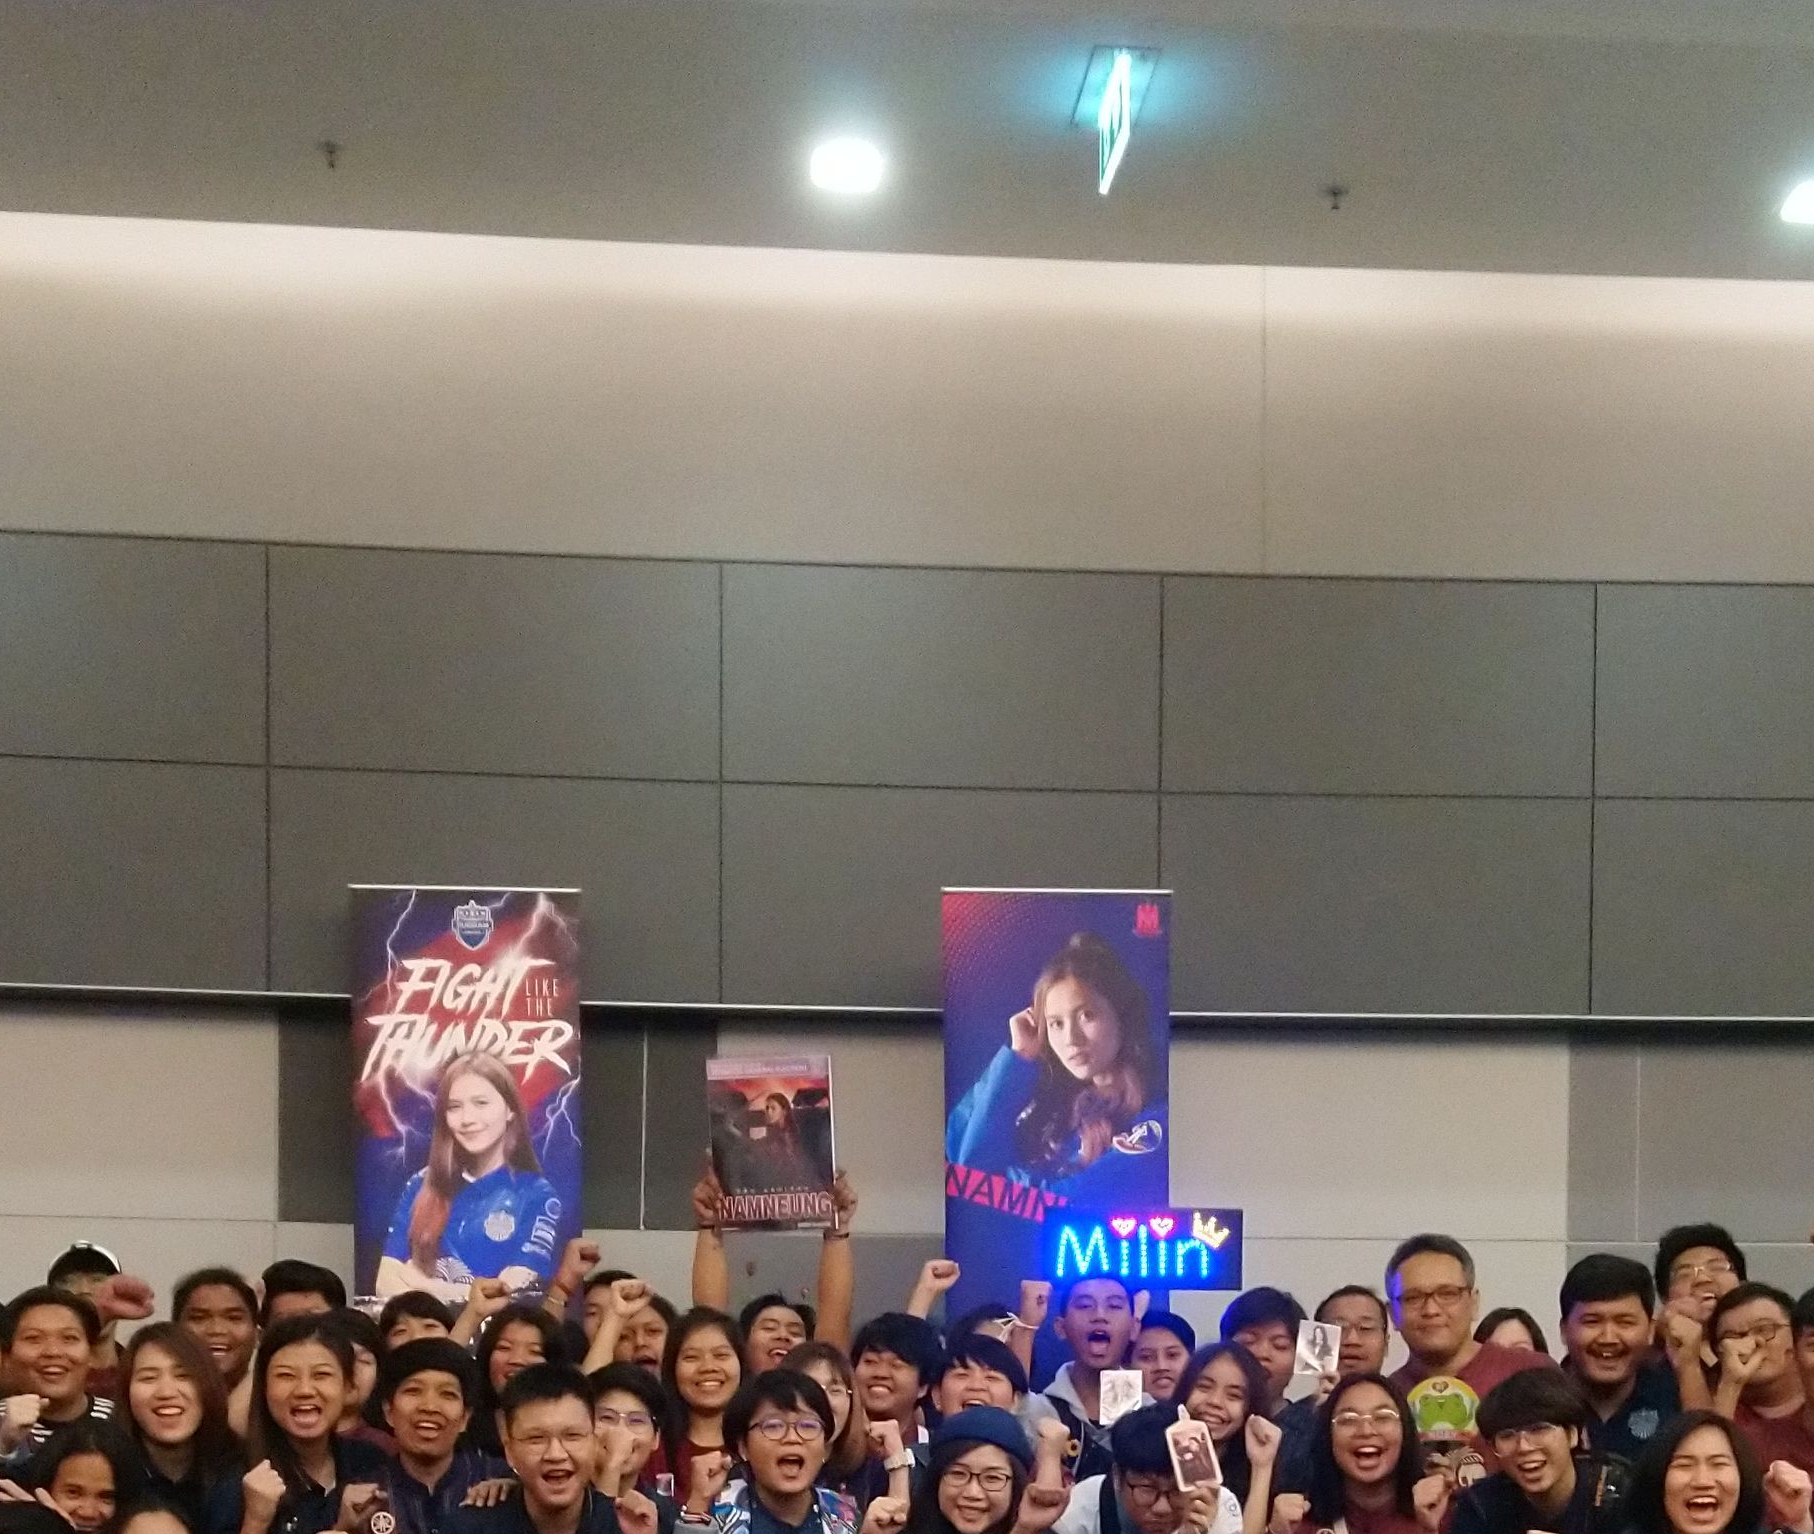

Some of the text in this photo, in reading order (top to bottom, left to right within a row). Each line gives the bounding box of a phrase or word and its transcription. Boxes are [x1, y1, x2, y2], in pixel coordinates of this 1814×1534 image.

[395, 956, 556, 1021] FIGHT
[525, 978, 559, 997] LIKE
[525, 998, 553, 1017] THE
[361, 1012, 574, 1087] THUNDER
[718, 1190, 835, 1222] NAMNEUNG
[1055, 1217, 1210, 1278] Milin
